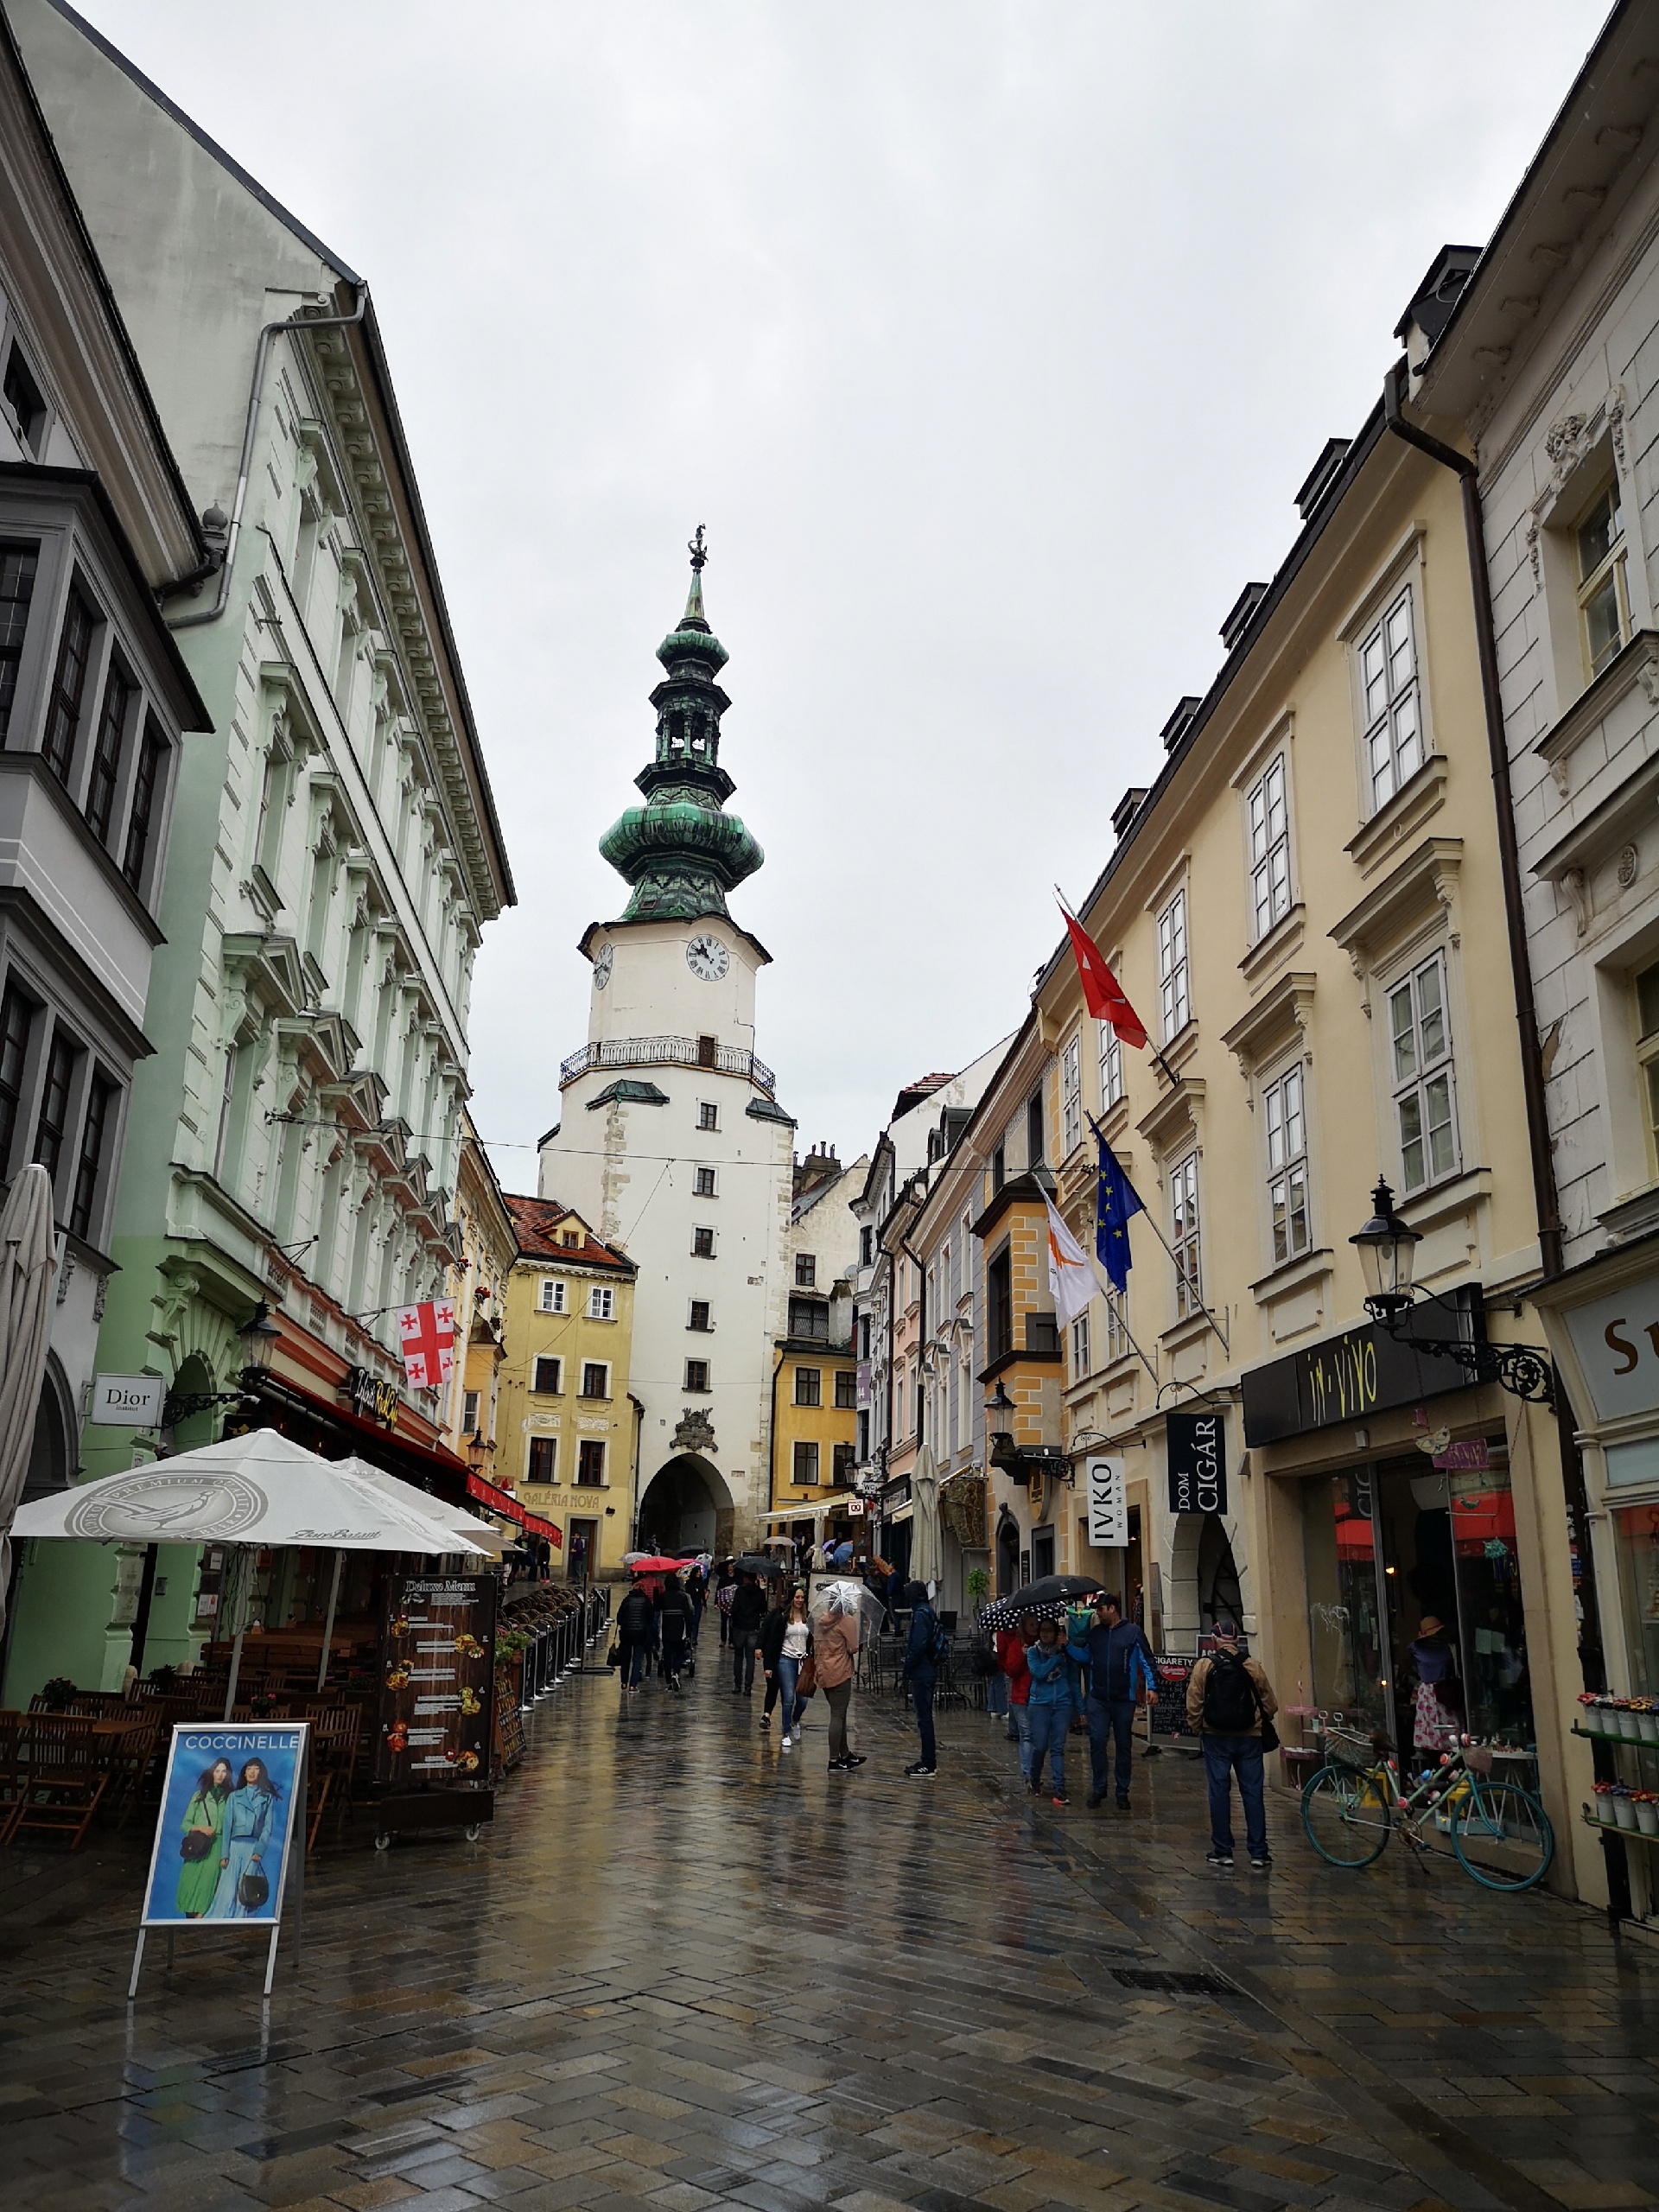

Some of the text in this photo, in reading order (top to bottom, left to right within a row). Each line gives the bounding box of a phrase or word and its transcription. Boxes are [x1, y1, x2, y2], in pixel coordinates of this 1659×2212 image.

[105, 1389, 150, 1405] Dior
[1191, 1417, 1218, 1511] CIGÁR
[112, 1478, 249, 1514] PREMIUM QUALITY
[1178, 1471, 1191, 1510] DOM
[523, 1491, 600, 1509] GALÉRIA NOVA
[1092, 1464, 1114, 1539] IVKO
[200, 1520, 238, 1535] BEER
[405, 1580, 476, 1592] Deluxe Menu
[185, 1735, 299, 1750] COCCINELLE
